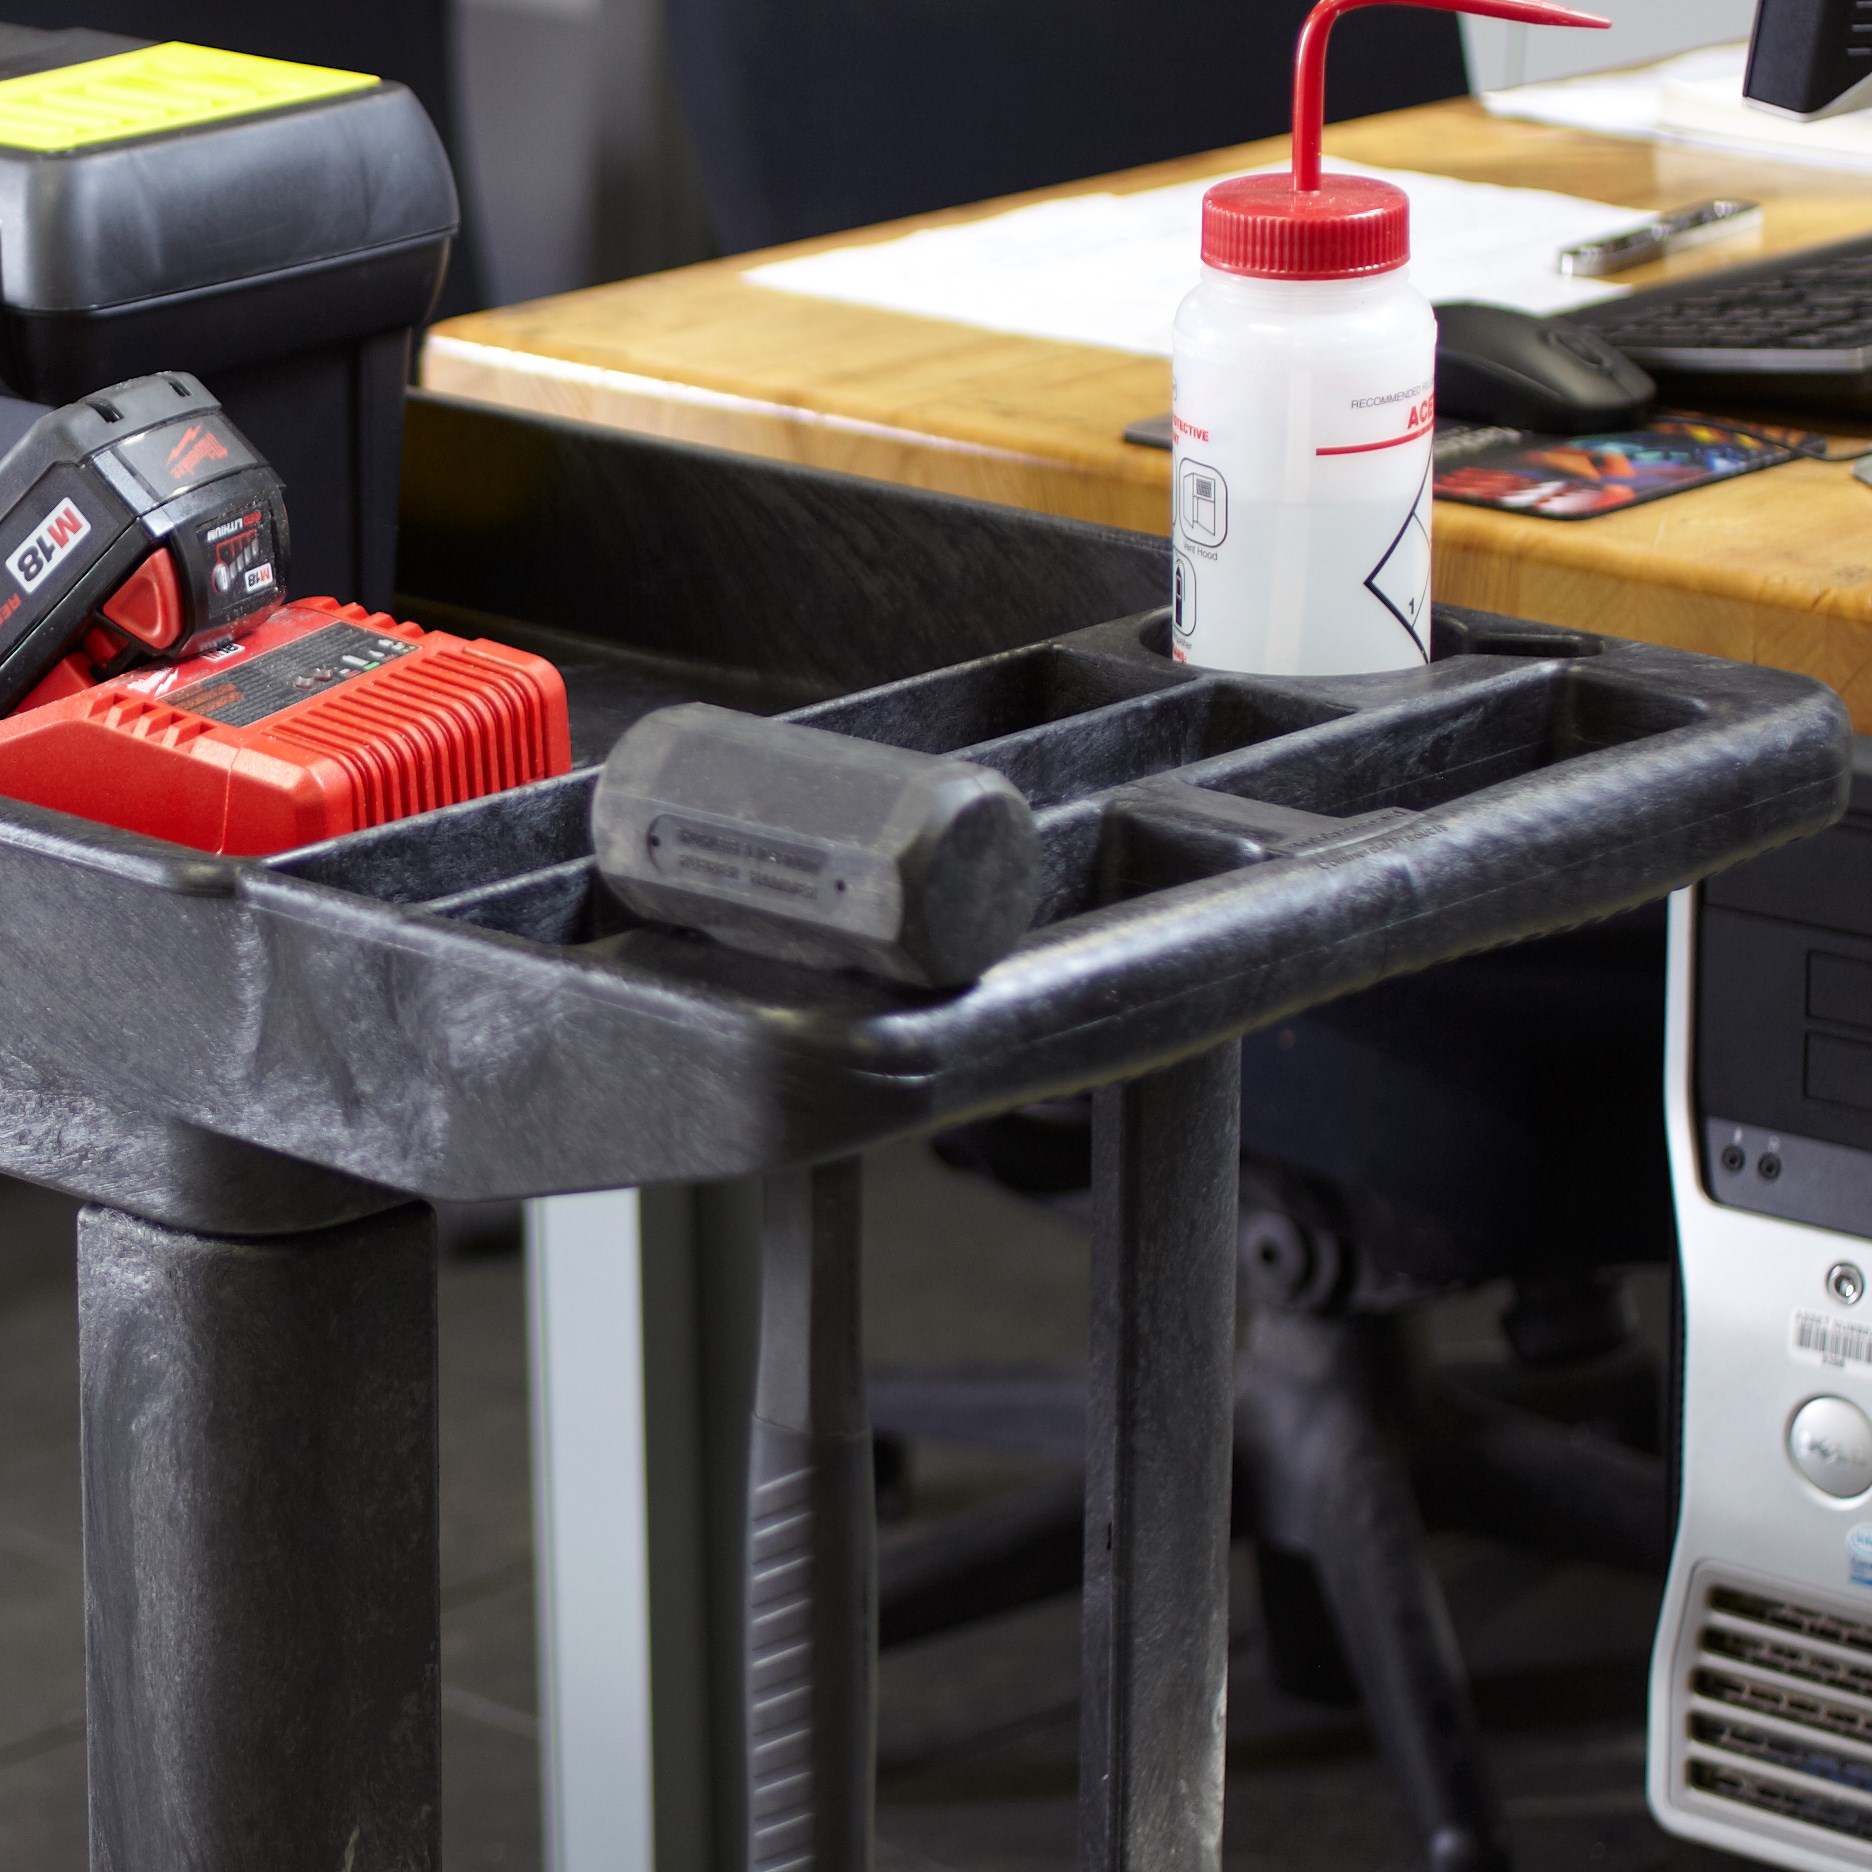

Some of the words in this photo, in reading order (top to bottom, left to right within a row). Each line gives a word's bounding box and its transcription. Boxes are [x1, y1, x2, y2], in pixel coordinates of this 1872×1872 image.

[17, 506, 84, 583] M18
[248, 571, 271, 587] M18
[1408, 597, 1415, 615] 1
